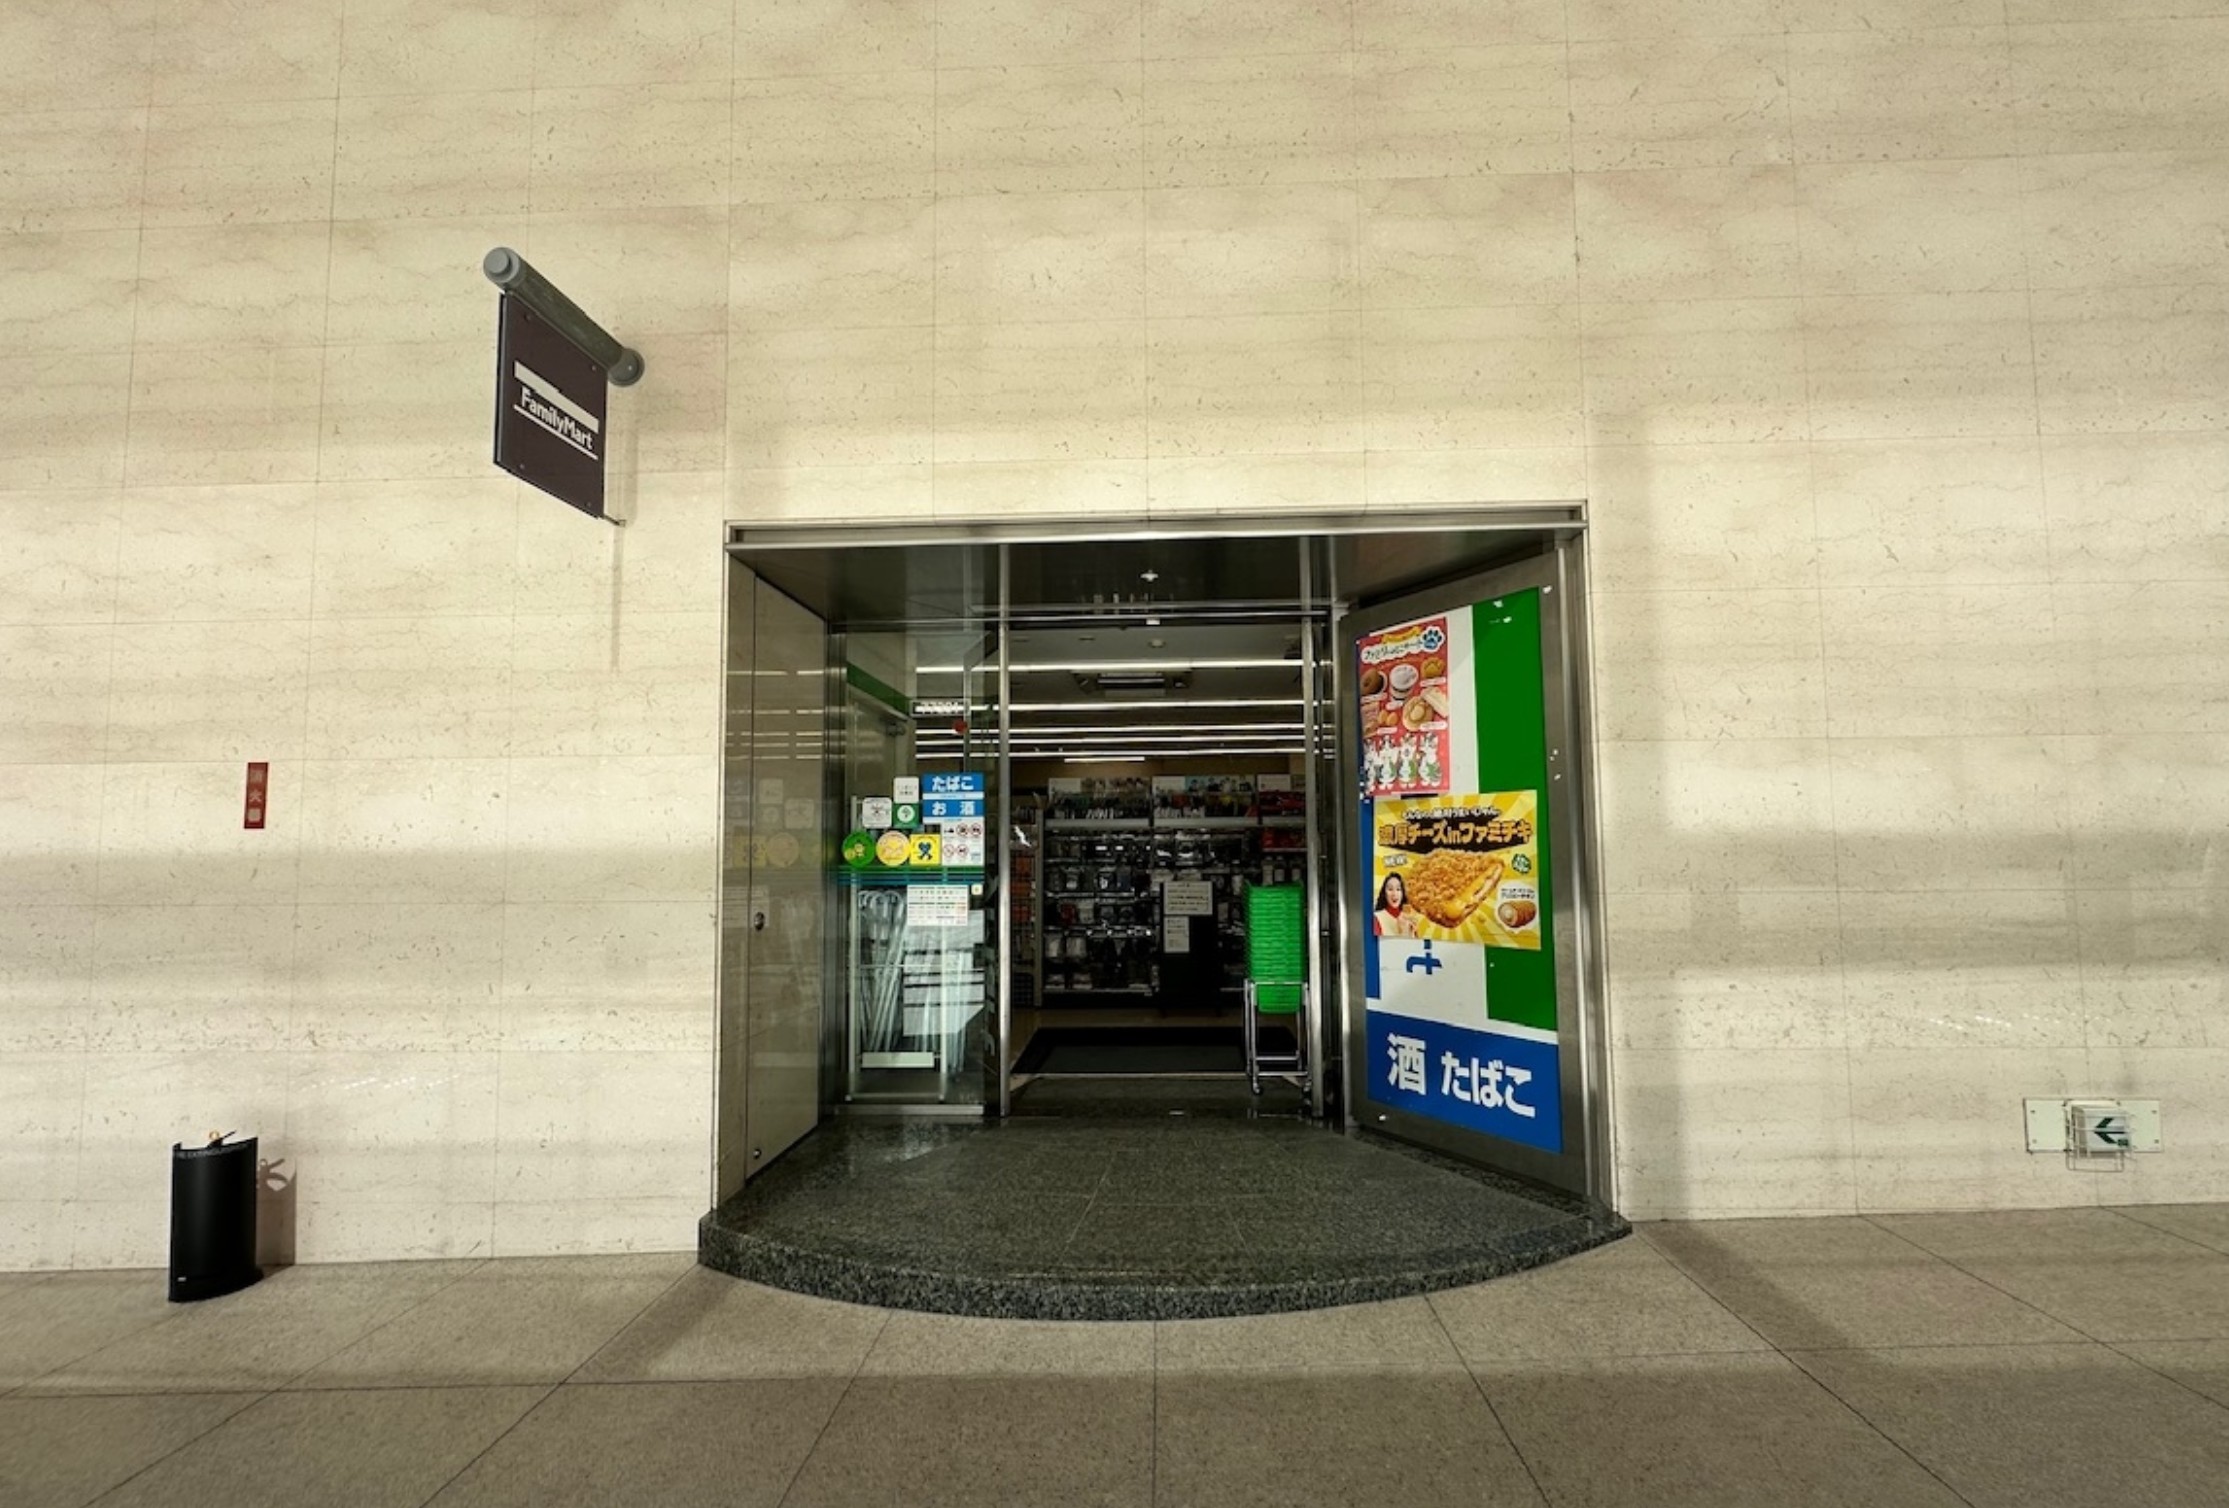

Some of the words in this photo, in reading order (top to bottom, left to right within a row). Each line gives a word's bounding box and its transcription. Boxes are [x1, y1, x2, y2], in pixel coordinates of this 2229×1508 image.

[521, 386, 593, 450] FamilyMart
[932, 776, 974, 792] たばこ
[1387, 1032, 1426, 1095] 酒
[1441, 1051, 1535, 1118] たばこ
